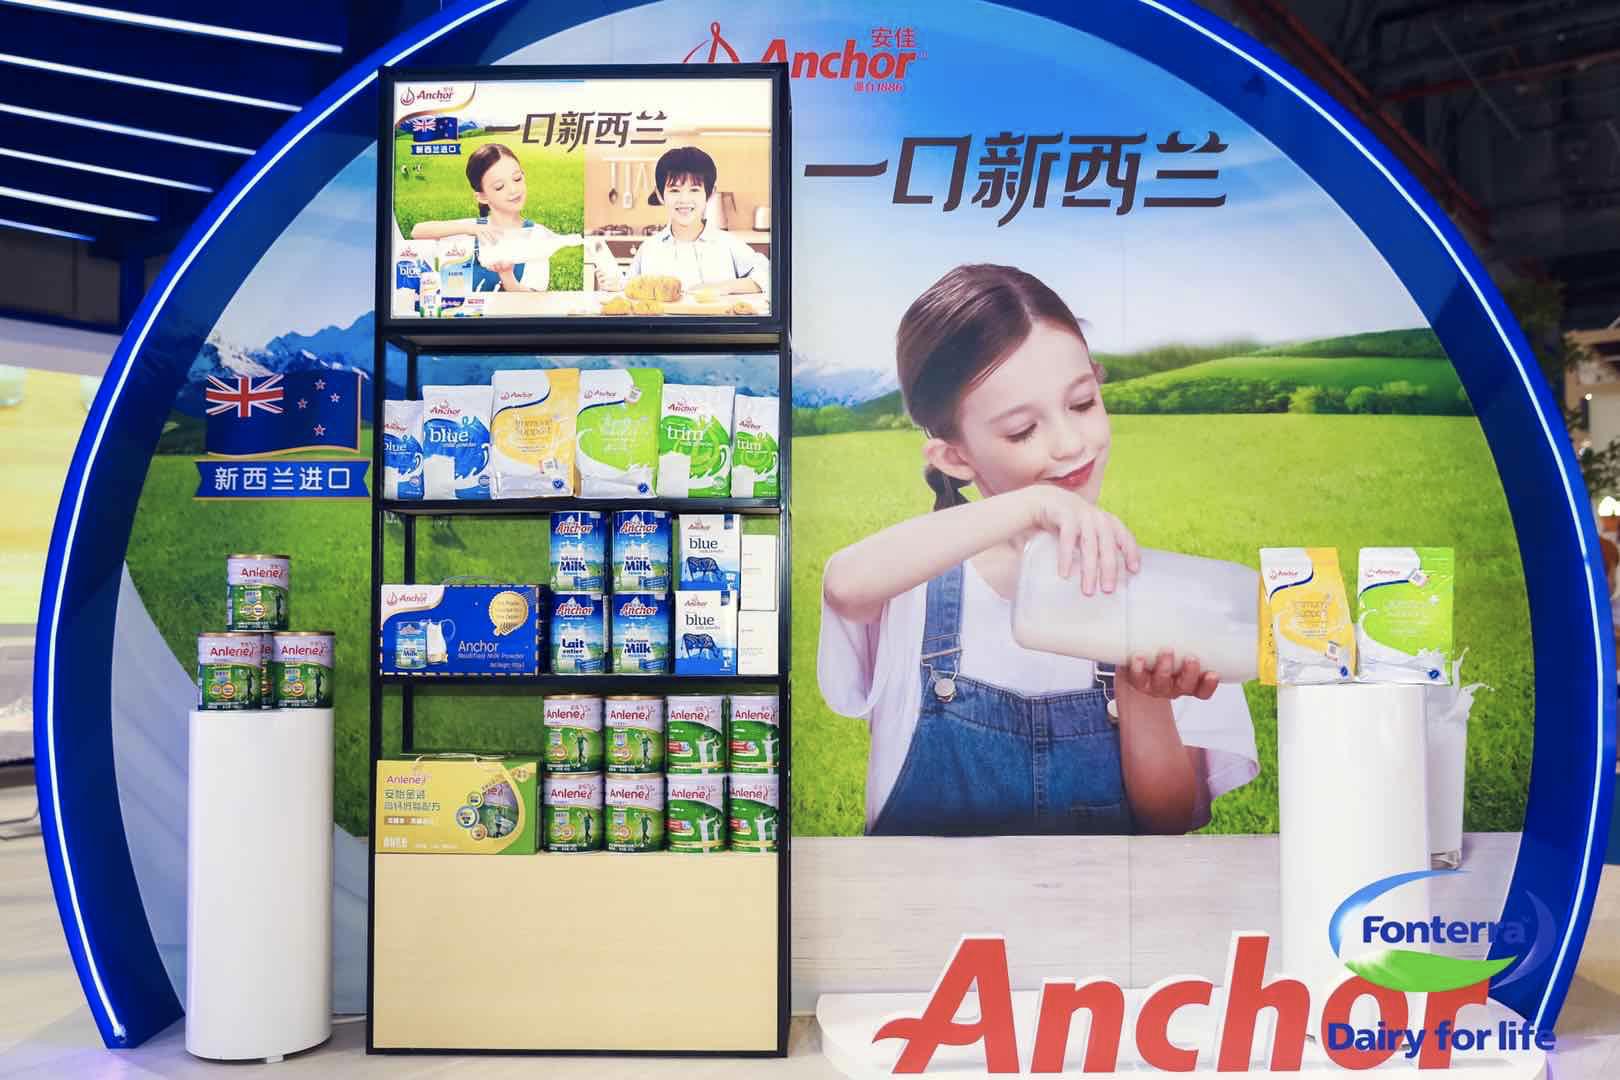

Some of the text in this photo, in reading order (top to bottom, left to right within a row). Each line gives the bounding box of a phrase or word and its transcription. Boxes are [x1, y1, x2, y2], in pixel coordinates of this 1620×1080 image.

[871, 27, 917, 48] 安佳
[761, 39, 916, 79] Anchor
[416, 90, 454, 101] Anchor
[485, 110, 669, 153] 一口新西兰
[804, 131, 1229, 227] 一口新西兰
[431, 406, 461, 415] Anchor
[668, 402, 698, 412] Anchor
[430, 428, 469, 442] blue
[667, 425, 704, 440] trim
[215, 467, 350, 491] 新西兰进口
[555, 521, 593, 534] Anchor
[620, 521, 657, 534] Anchor
[689, 538, 718, 549] blue
[560, 561, 586, 571] Milk
[625, 561, 651, 571] Milk
[240, 568, 280, 578] Anlene
[555, 603, 593, 616] Anchor
[619, 603, 657, 616] Anchor
[685, 614, 715, 625] blue
[458, 640, 499, 652] Anchor
[562, 638, 584, 648] Lait
[624, 643, 650, 654] Milk
[210, 647, 251, 657] Anlene
[281, 645, 319, 656] Anlene
[546, 710, 581, 719] Anlene
[610, 710, 646, 720] Anlene
[671, 710, 704, 720] Anlene
[735, 710, 770, 720] Anlene
[386, 776, 422, 785] Anlene
[551, 788, 589, 799] Anlene
[610, 788, 646, 799] Anlene
[672, 788, 706, 799] Anlene
[730, 787, 763, 799] Anlene
[872, 935, 1489, 1073] Anchor
